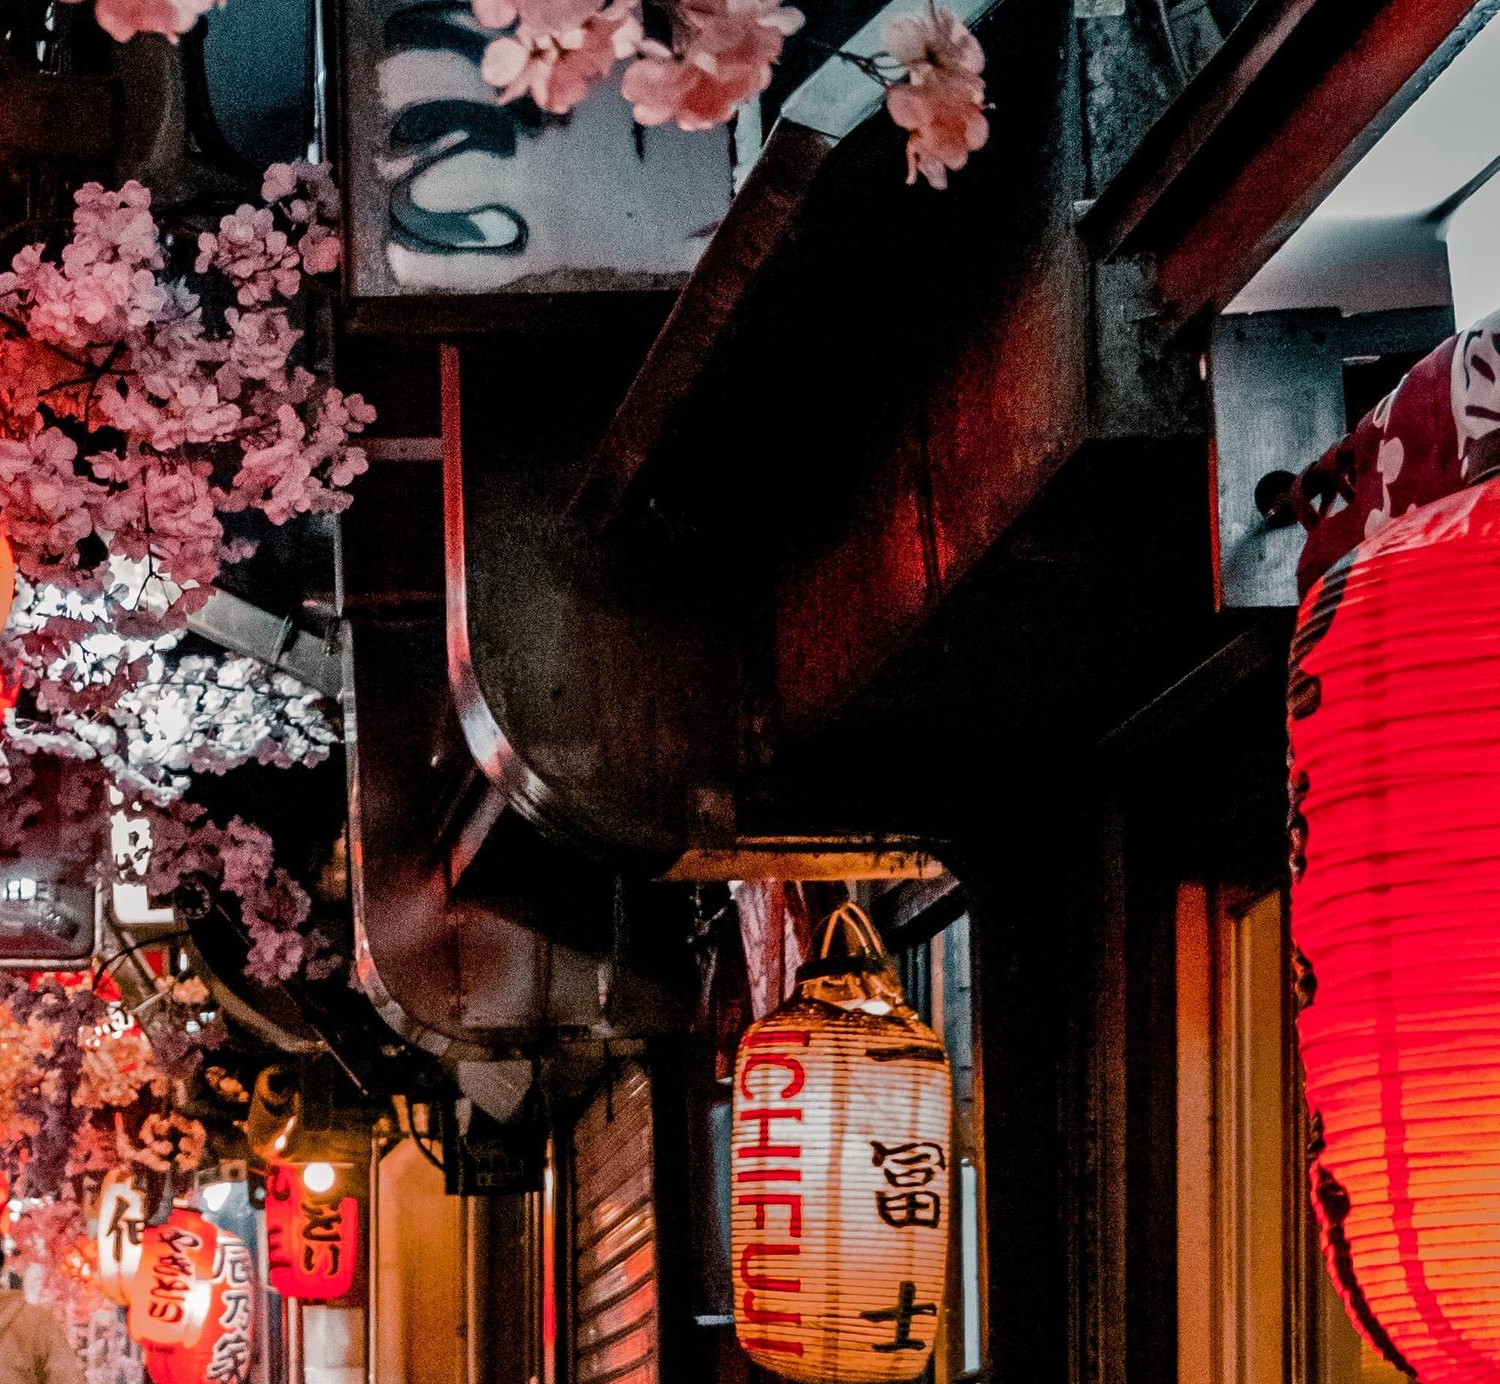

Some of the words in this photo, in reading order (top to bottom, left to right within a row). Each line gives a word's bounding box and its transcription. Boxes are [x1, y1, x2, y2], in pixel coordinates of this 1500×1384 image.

[738, 1030, 811, 1356] ICHIFUJI
[860, 1047, 946, 1353] 一富士
